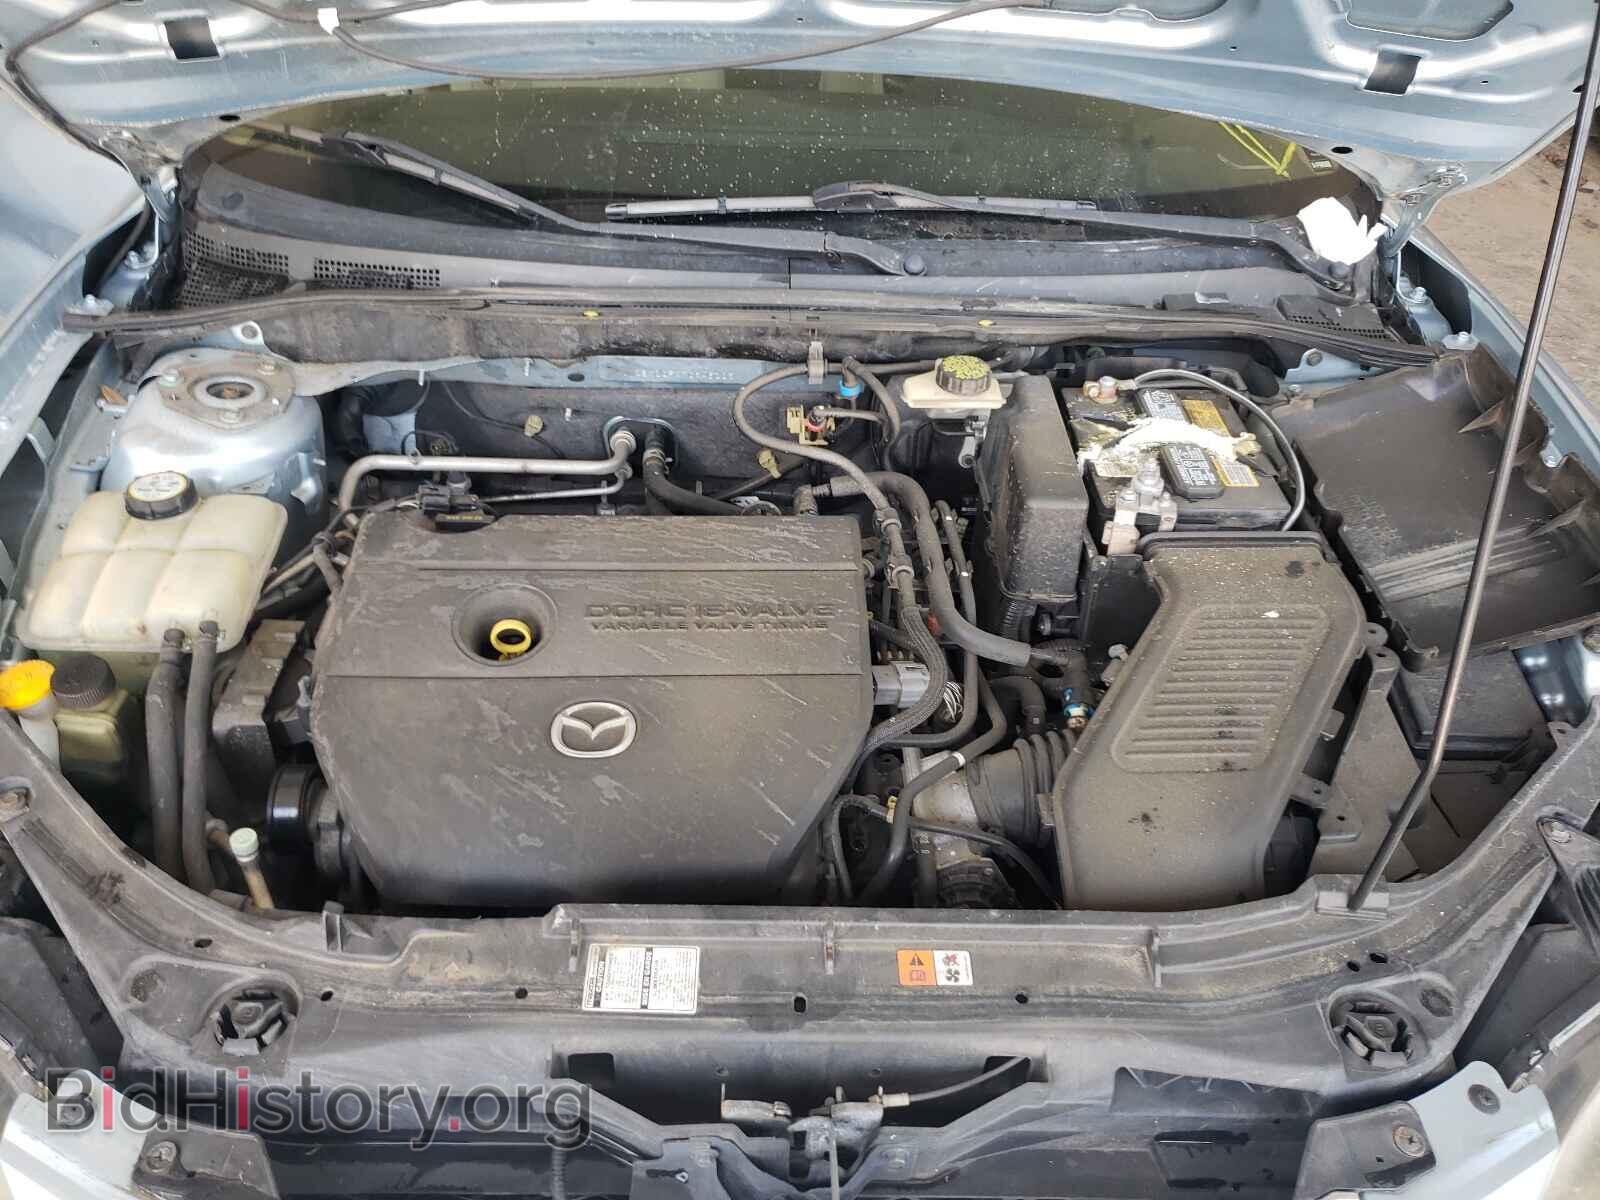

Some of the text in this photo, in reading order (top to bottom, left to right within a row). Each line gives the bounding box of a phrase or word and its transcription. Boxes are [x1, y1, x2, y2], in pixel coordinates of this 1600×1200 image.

[586, 603, 834, 617] DOHC 16-VALVE
[592, 621, 688, 631] VARIABLE
[694, 621, 753, 631] VALVE
